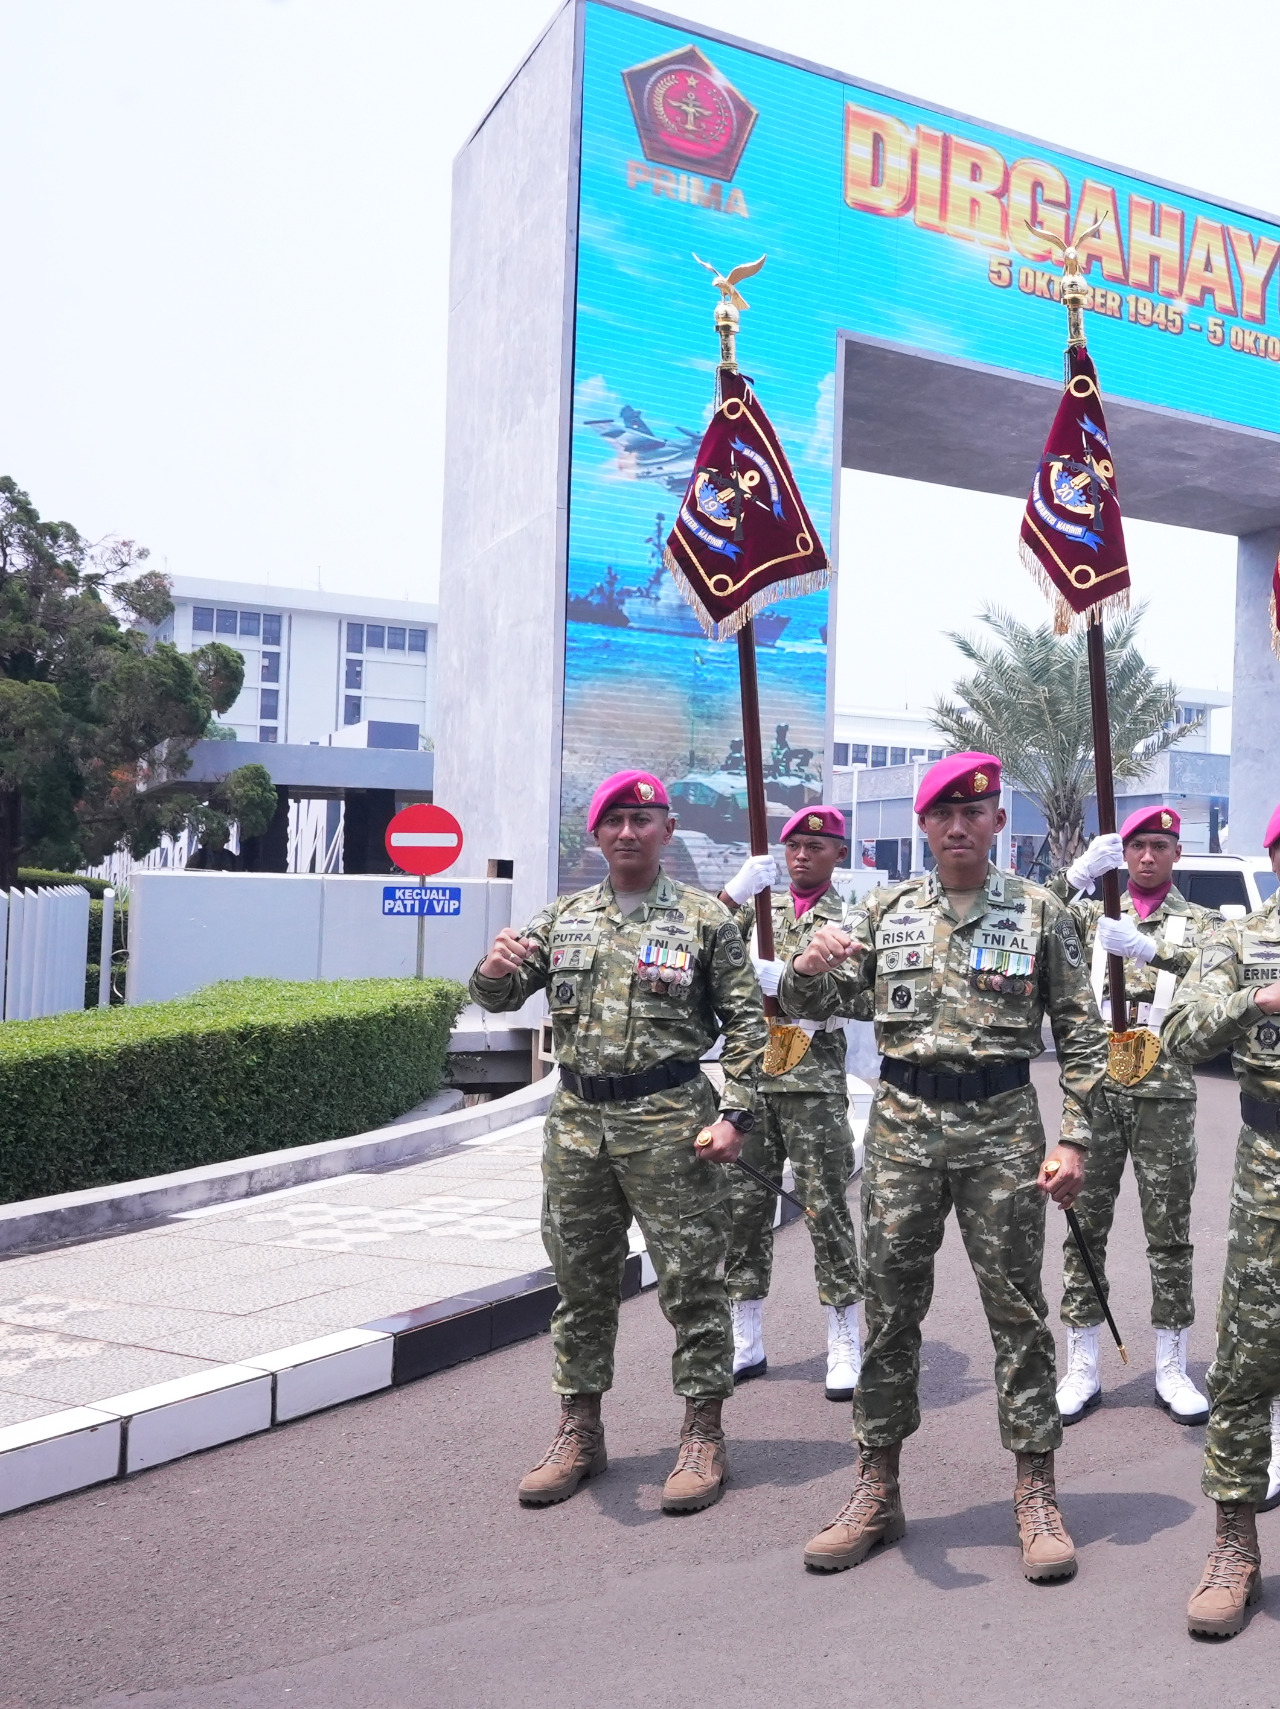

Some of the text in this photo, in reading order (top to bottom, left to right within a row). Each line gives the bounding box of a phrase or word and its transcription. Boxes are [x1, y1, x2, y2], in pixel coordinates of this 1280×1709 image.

[625, 159, 750, 220] PRIMA
[988, 253, 1013, 288] 5
[1018, 266, 1123, 320] OKTBER
[1126, 293, 1184, 335] 1945
[1206, 316, 1226, 347] 5
[1056, 483, 1075, 502] 20
[702, 496, 719, 512] 19
[1055, 520, 1083, 536] MARINIR
[697, 528, 724, 548] MARINIR
[395, 888, 450, 901] KECUALI
[384, 900, 420, 914] PATI
[433, 900, 460, 913] VIP
[552, 933, 592, 944] PUTRA
[647, 937, 692, 954] TNI AL
[882, 930, 926, 945] RISKA
[982, 933, 1029, 951] TNI AL
